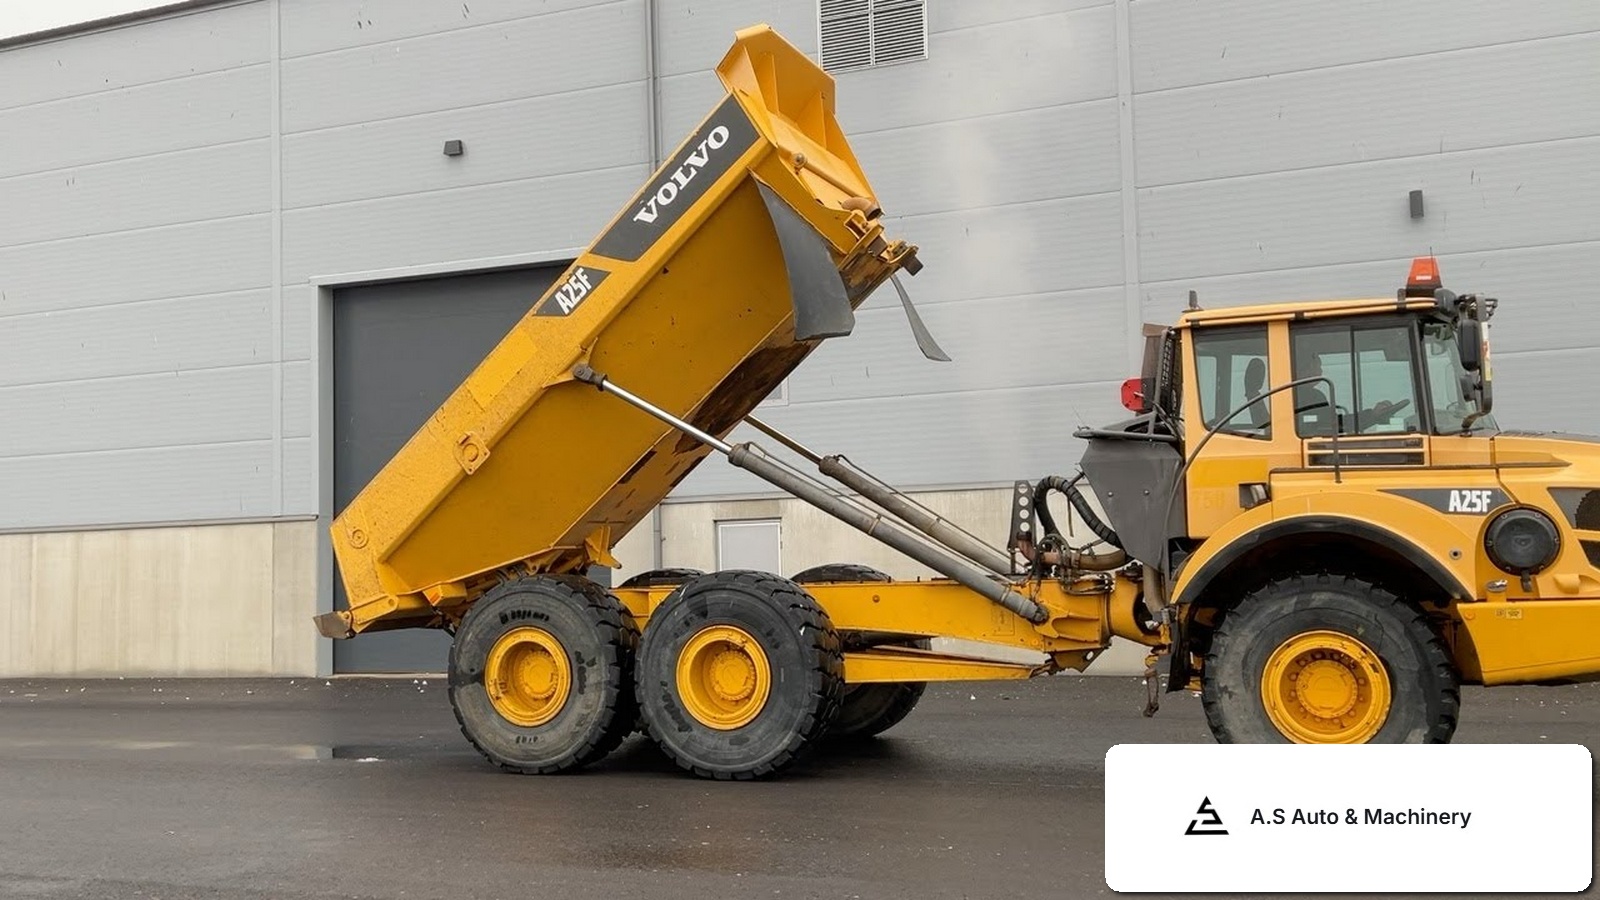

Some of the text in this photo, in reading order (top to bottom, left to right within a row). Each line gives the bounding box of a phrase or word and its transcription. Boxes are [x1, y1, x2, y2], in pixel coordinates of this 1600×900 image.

[633, 125, 730, 224] VOLVO
[554, 267, 592, 315] A25F
[1448, 489, 1492, 512] A25F
